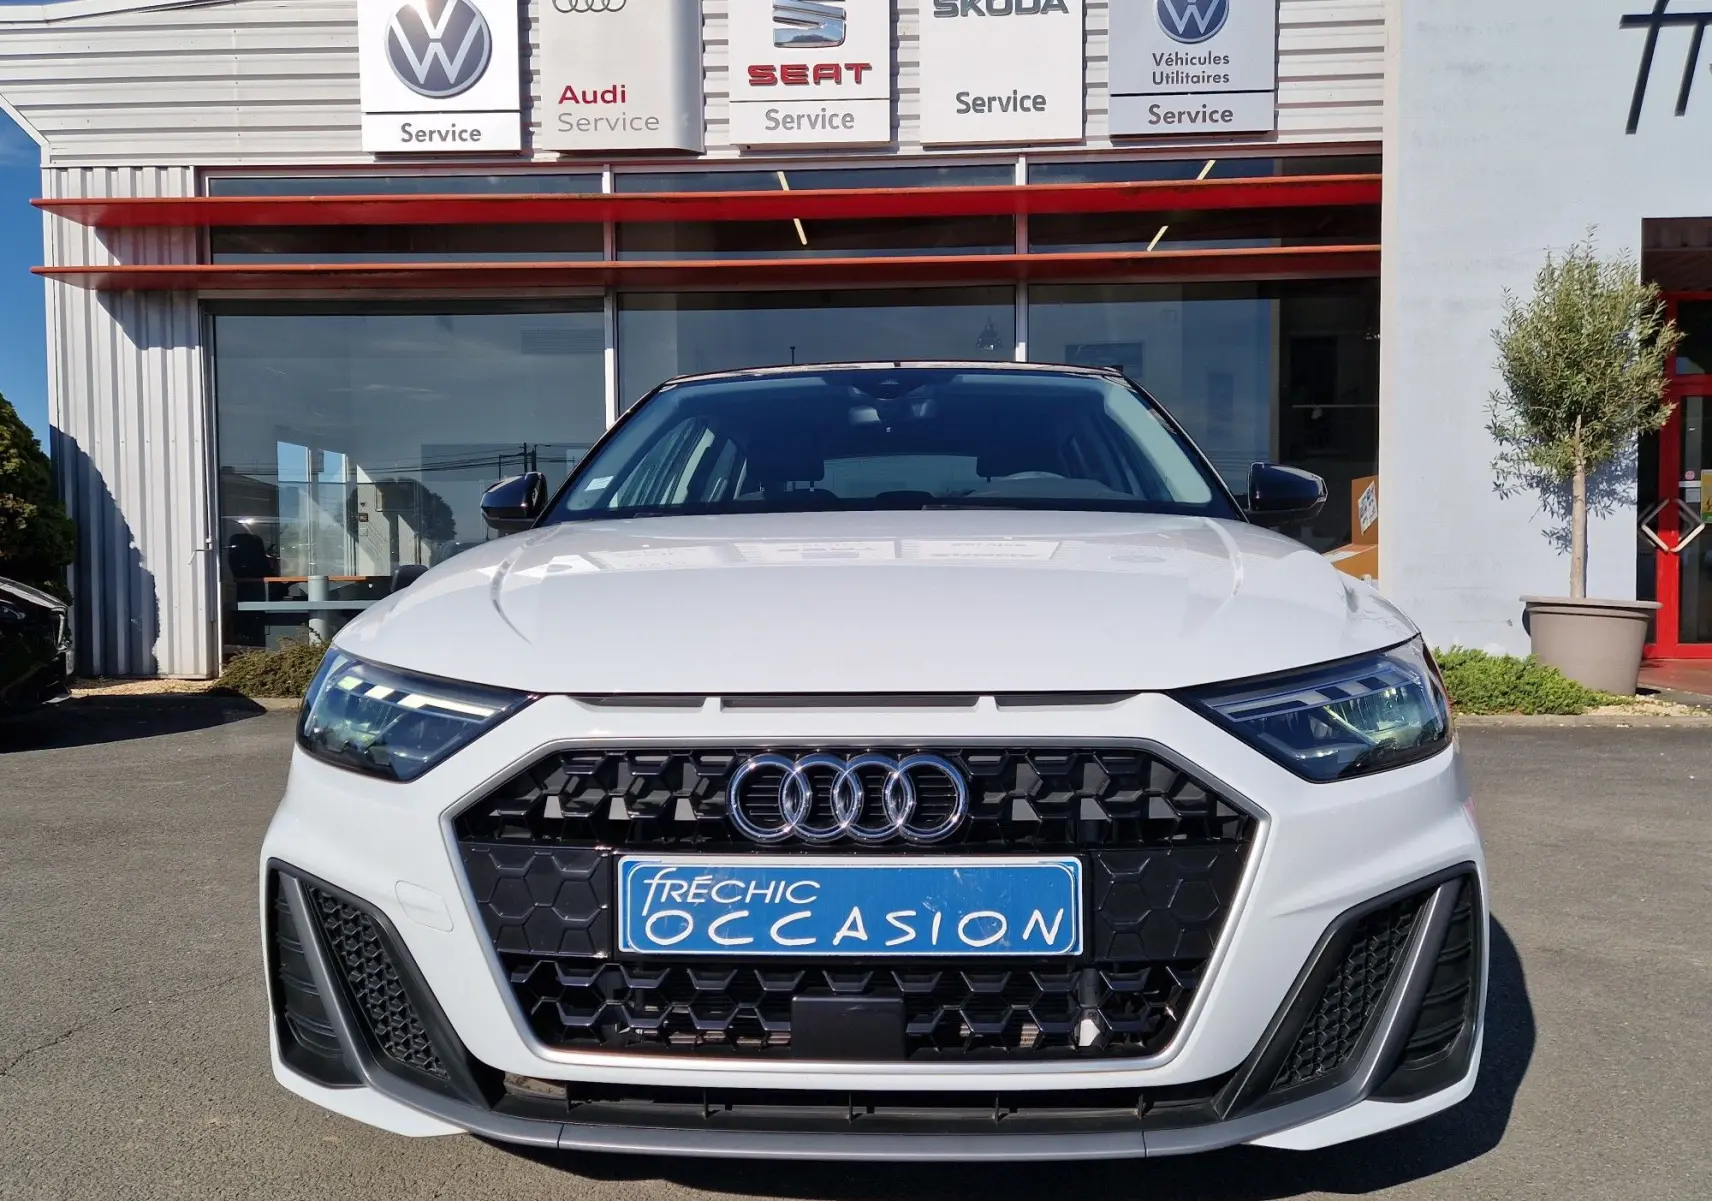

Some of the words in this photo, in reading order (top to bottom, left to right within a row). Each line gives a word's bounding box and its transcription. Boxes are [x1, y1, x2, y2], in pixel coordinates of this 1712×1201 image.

[1151, 52, 1230, 67] Véhicules
[747, 63, 872, 86] SEAT
[1151, 71, 1230, 86] Utilitaires
[558, 85, 627, 105] Audi
[955, 90, 1047, 114] Service
[557, 112, 660, 133] Service
[764, 108, 855, 131] Service
[1148, 104, 1234, 126] Service
[400, 123, 482, 143] Service
[644, 906, 1064, 947] OCCASION
